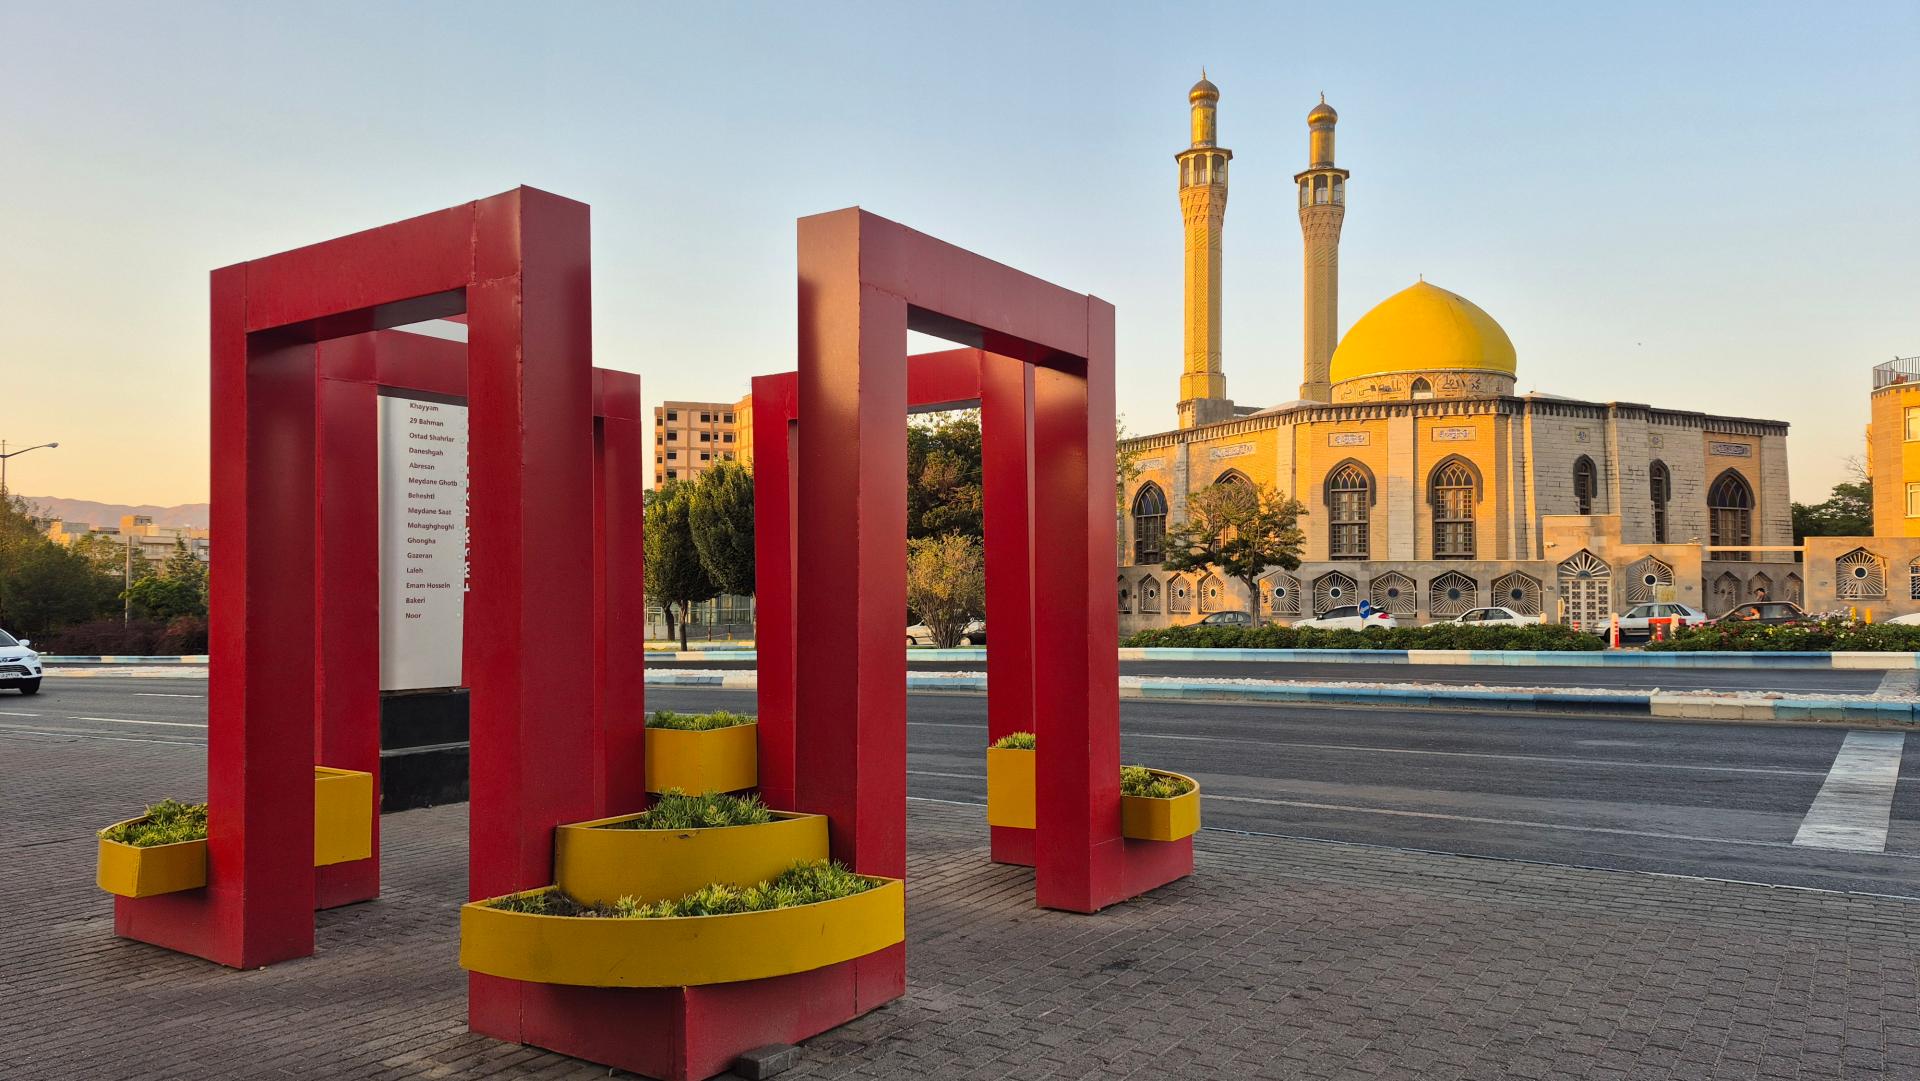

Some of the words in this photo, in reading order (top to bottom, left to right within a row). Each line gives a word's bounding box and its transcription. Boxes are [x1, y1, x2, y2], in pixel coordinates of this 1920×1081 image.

[409, 402, 439, 411] Khayyam
[419, 418, 444, 427] Bahman
[409, 432, 428, 440] Ostad
[429, 434, 455, 443] Shahriar
[409, 447, 443, 456] Daneshgah
[409, 462, 435, 470] Abresan
[408, 477, 437, 486] Meydane
[438, 479, 458, 487] Ghotb
[408, 492, 435, 500] Beheshti
[408, 507, 437, 515] Meydane
[438, 508, 452, 516] Saat
